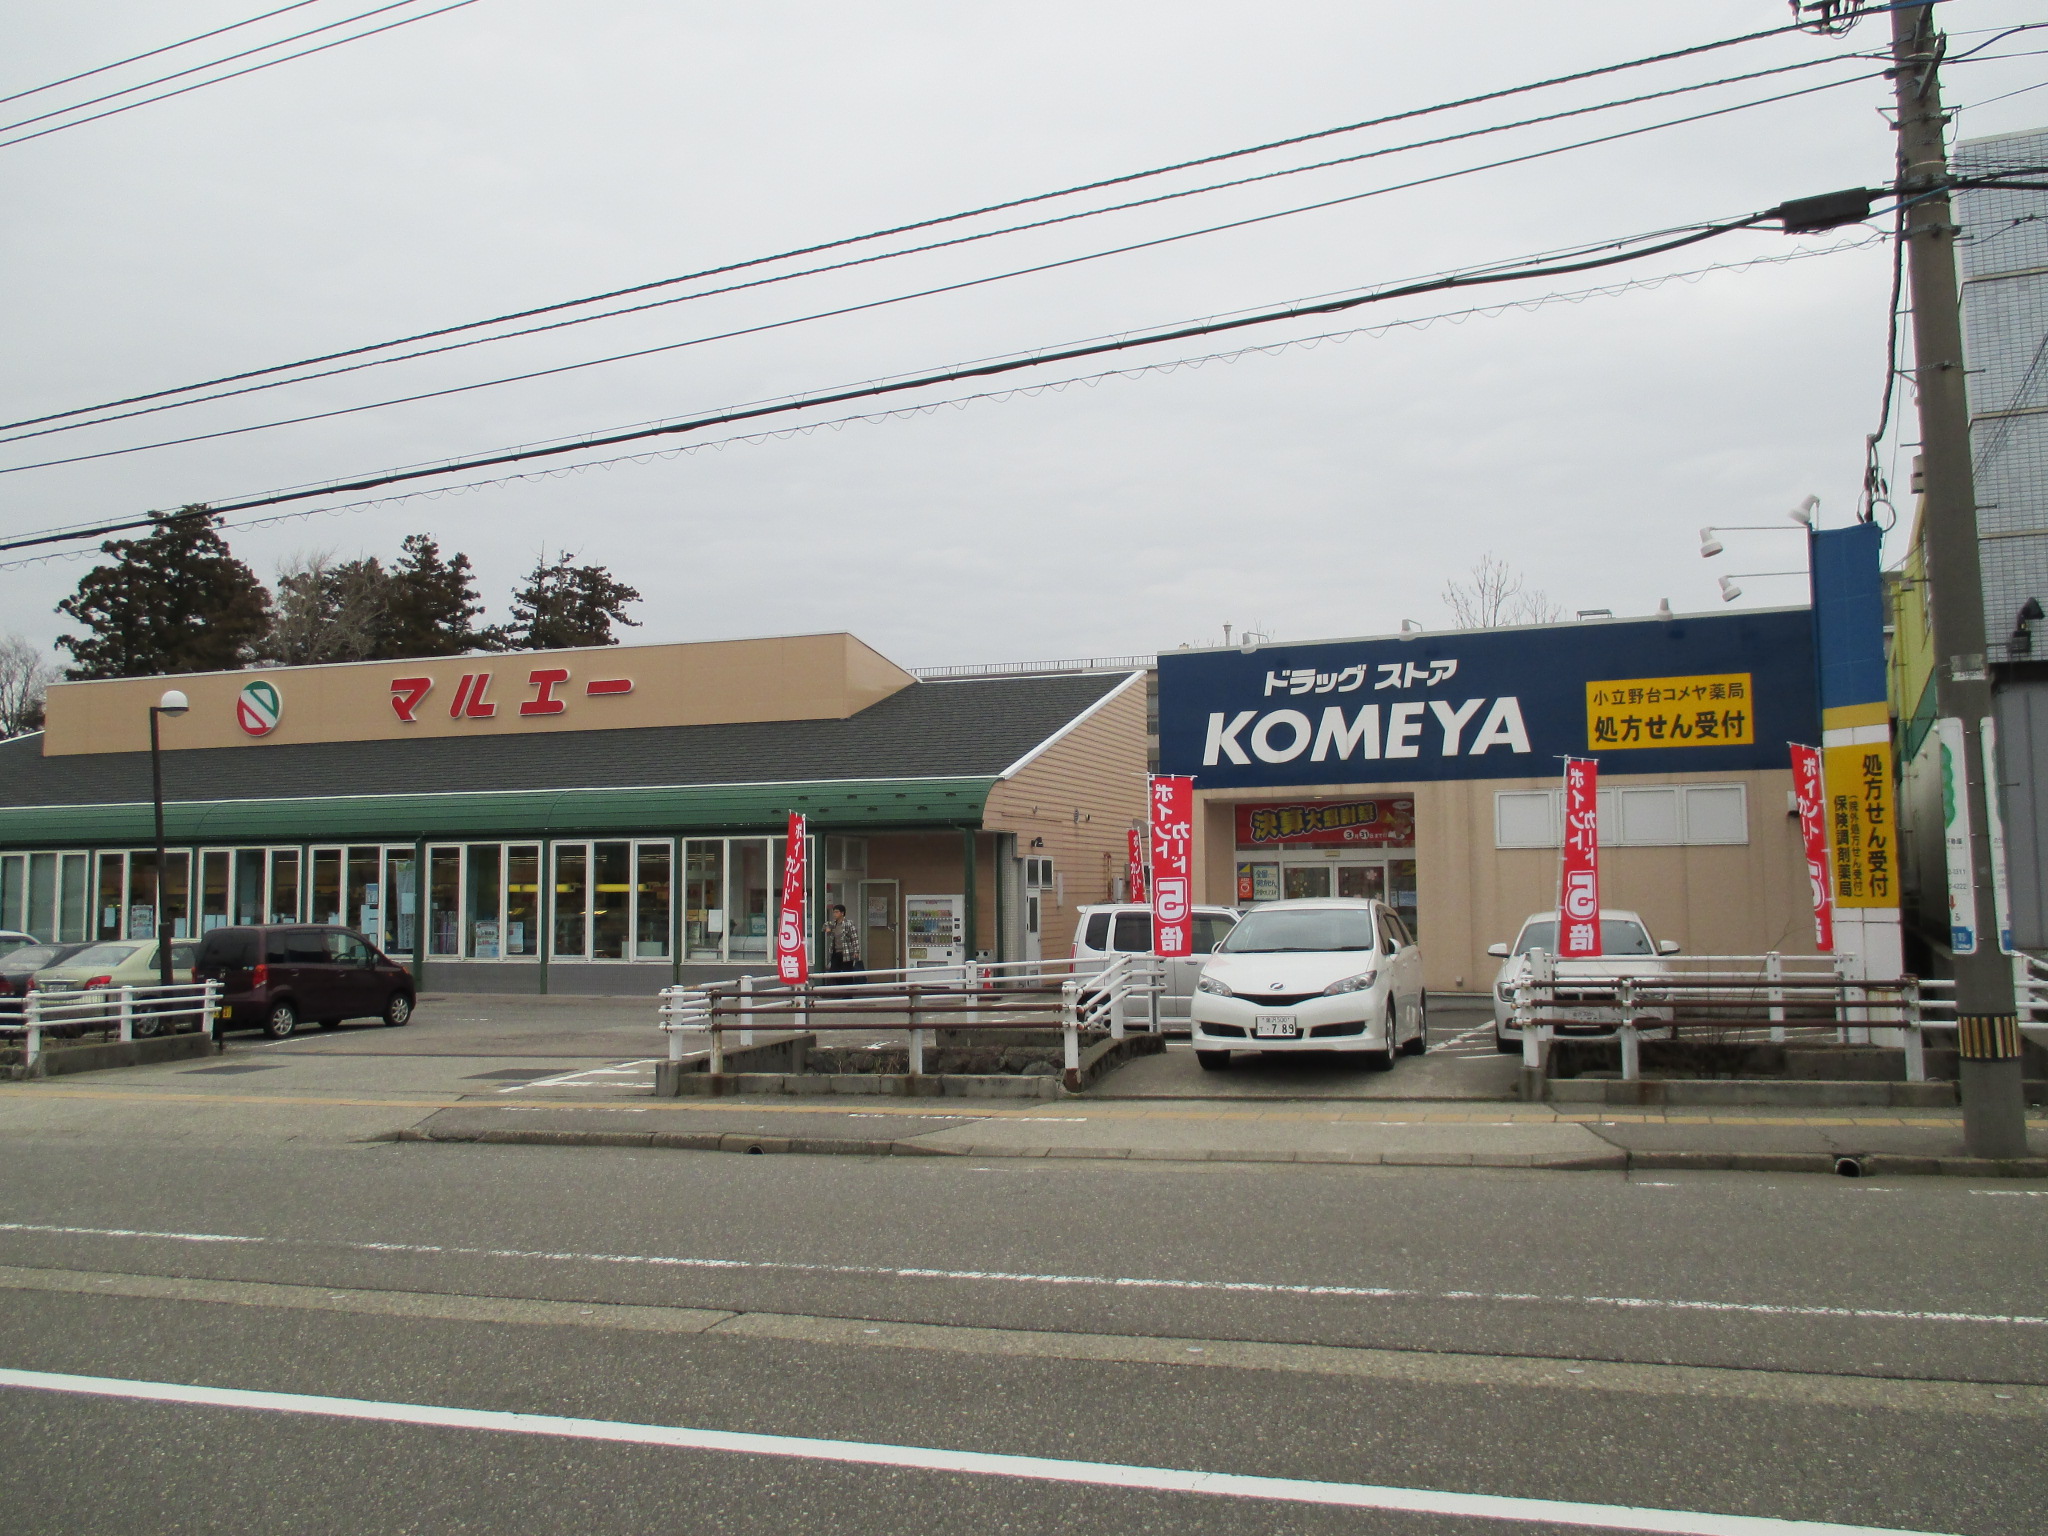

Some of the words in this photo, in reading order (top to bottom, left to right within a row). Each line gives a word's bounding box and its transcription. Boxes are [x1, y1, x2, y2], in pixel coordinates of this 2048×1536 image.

[390, 668, 635, 722] マルエー
[1264, 664, 1367, 697] ドラッグ
[1374, 659, 1458, 690] ストア
[1593, 682, 1744, 706] 小立野台コメヤ薬局
[1203, 696, 1532, 766] KOMEYA
[1594, 710, 1745, 742] 処方せん受付
[1803, 757, 1819, 839] ポイント
[1863, 754, 1888, 897] 処方せん受付
[792, 823, 803, 892] ポイント
[1834, 795, 1852, 897] 保険調剤薬局
[784, 855, 796, 904] カード
